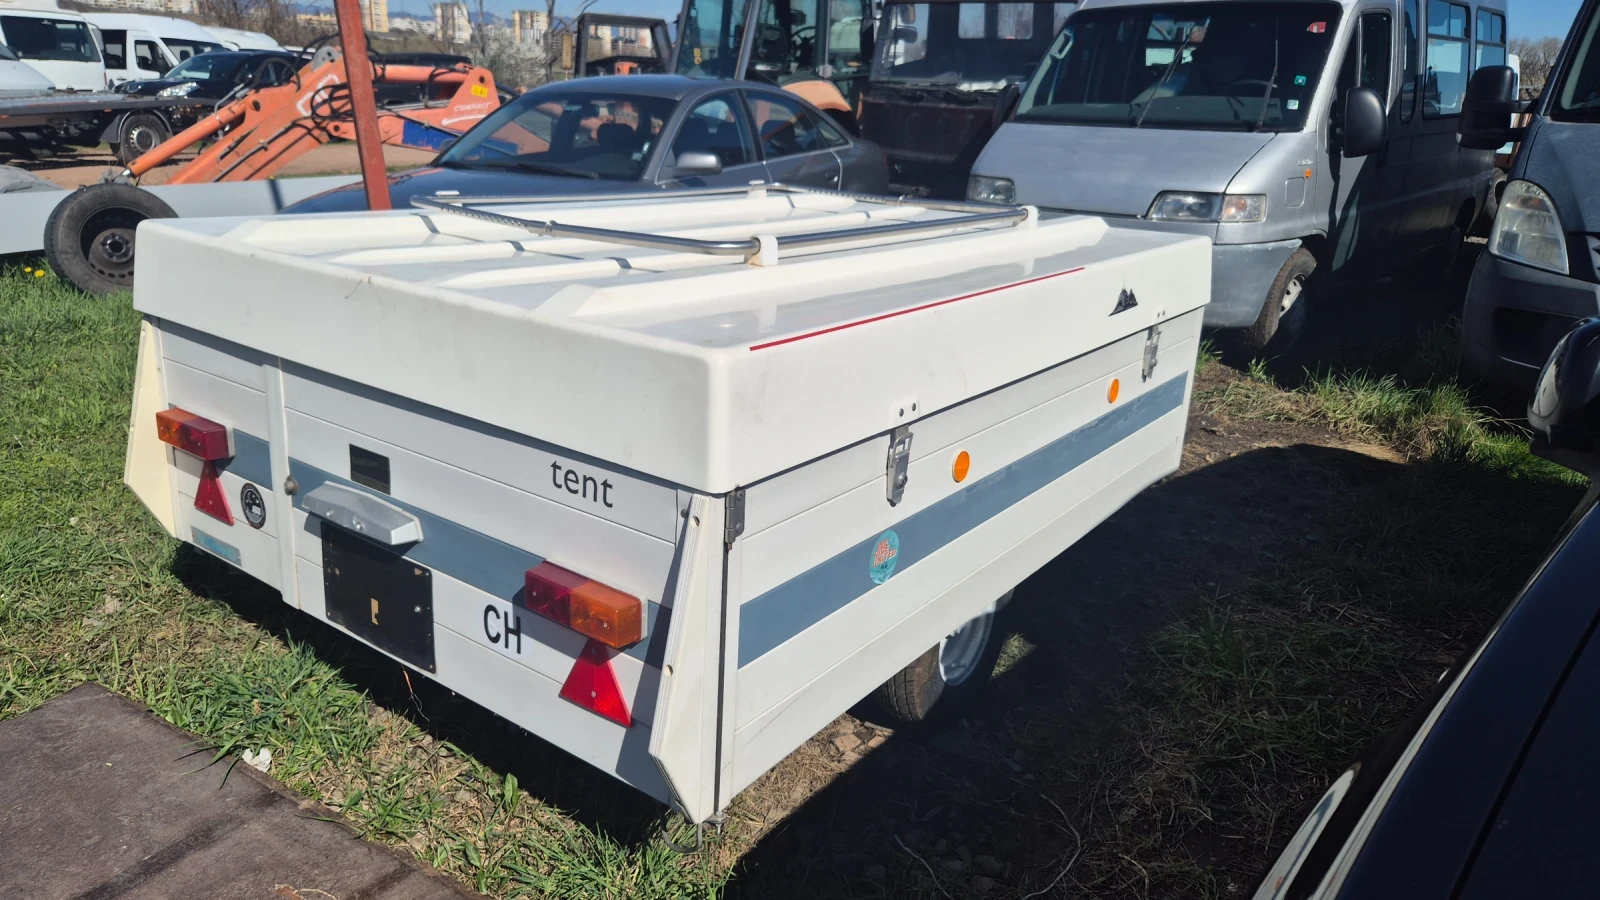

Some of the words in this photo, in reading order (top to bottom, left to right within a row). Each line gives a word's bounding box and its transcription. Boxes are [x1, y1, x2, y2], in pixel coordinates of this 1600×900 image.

[453, 101, 493, 113] COMPACT
[550, 460, 613, 508] tent
[483, 604, 522, 655] CH
